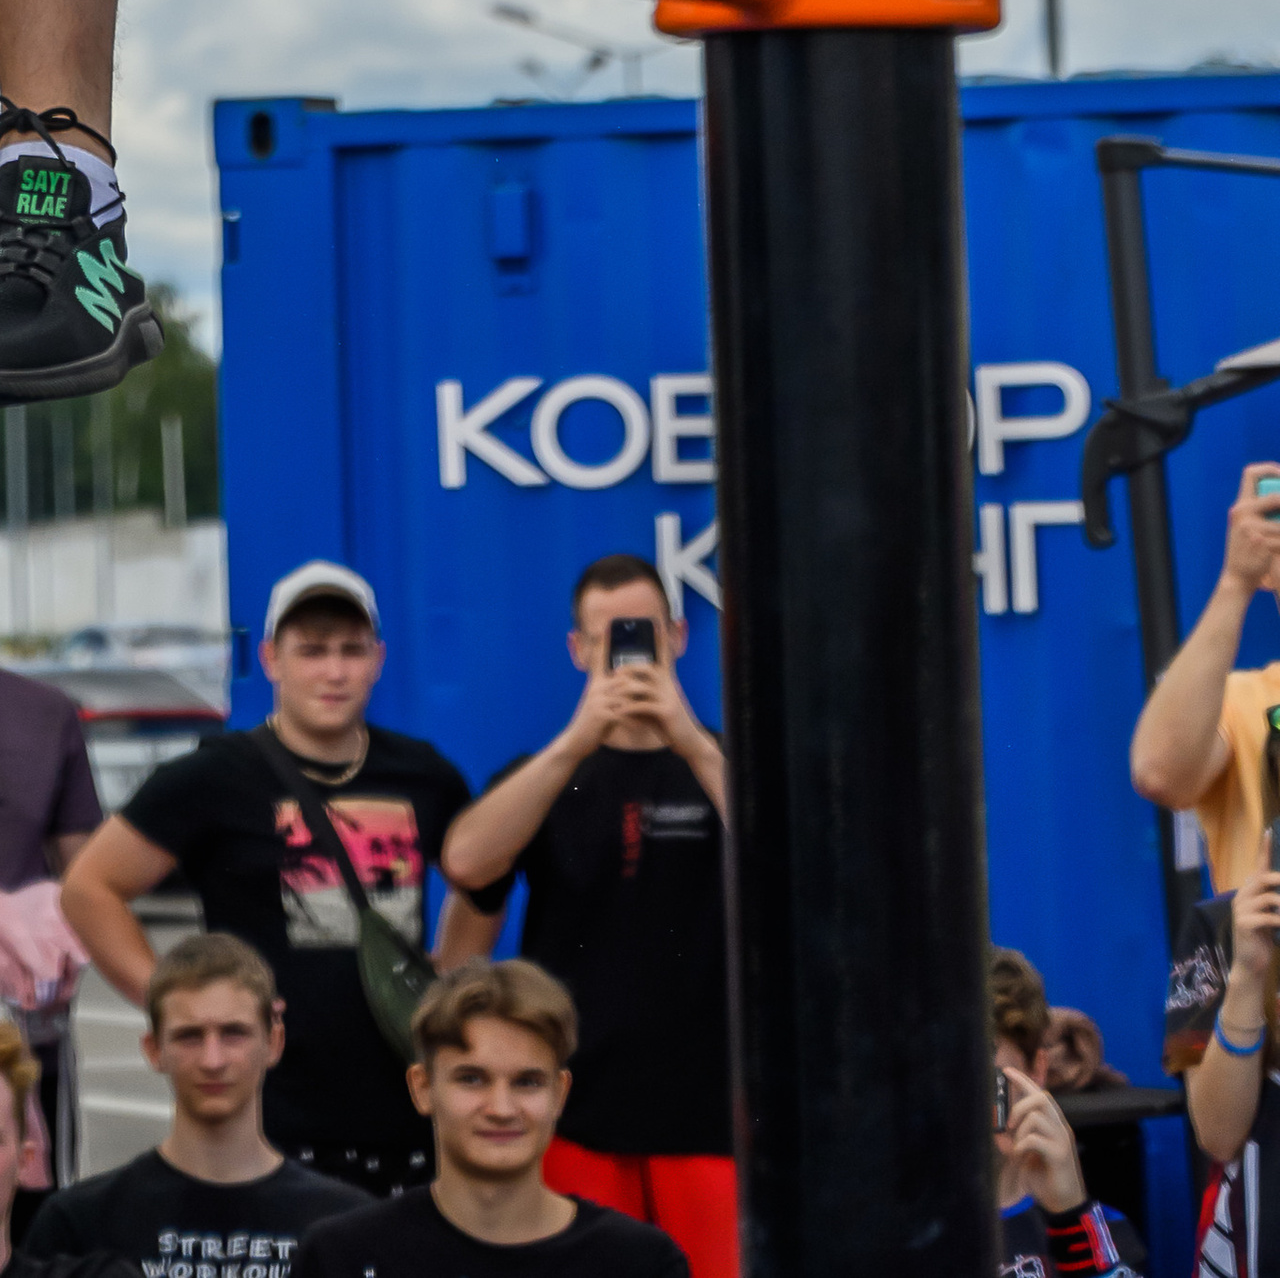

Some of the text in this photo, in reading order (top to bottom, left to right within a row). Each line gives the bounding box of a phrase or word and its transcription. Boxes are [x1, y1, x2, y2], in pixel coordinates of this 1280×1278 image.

[21, 169, 71, 195] SAYT
[16, 193, 67, 218] RLAE
[435, 362, 1091, 490] КОВР
[158, 1230, 298, 1259] STREET
[141, 1260, 292, 1278] WORKOU
